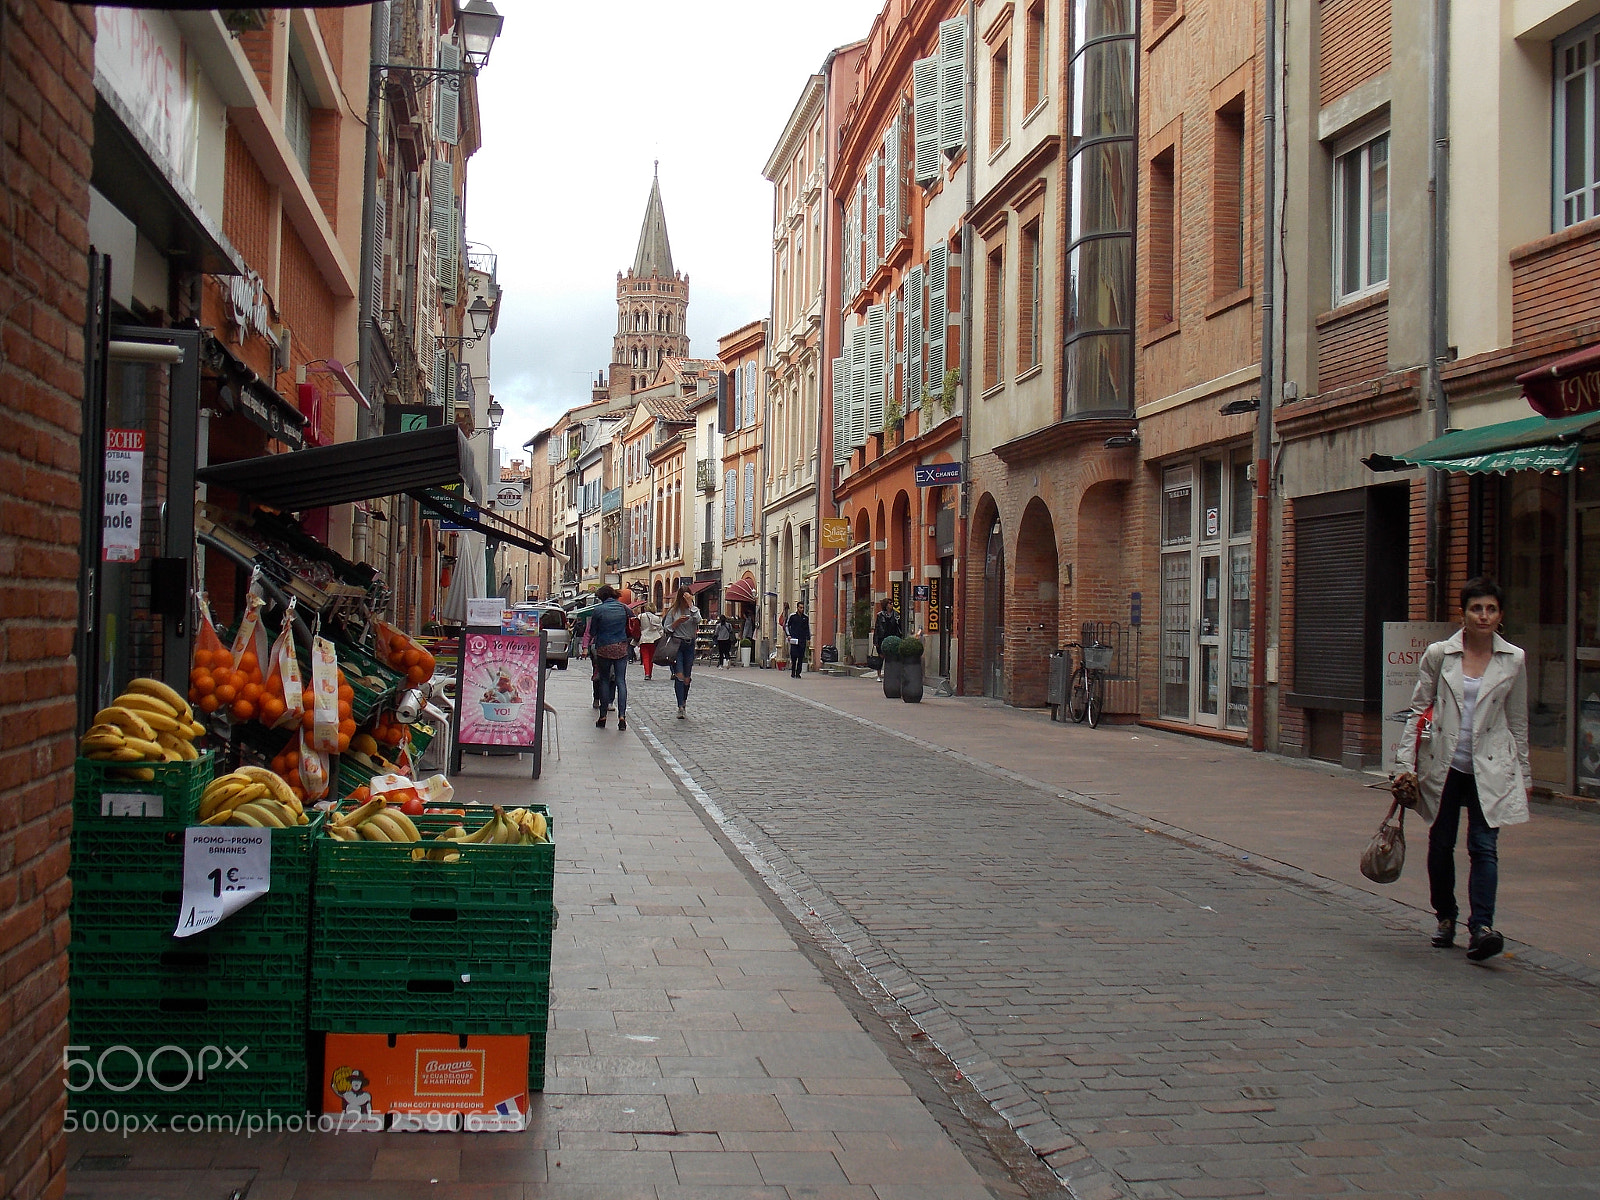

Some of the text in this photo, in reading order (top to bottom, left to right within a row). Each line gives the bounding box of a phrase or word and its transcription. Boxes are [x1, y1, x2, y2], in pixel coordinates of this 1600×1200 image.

[130, 9, 173, 120] PRICE
[106, 430, 143, 449] ÊCHE
[106, 451, 132, 459] OTBALL
[105, 470, 130, 484] use
[104, 493, 128, 506] ure
[469, 638, 488, 650] YO!
[1387, 651, 1427, 666] CAST
[493, 707, 511, 716] YO!
[208, 846, 248, 855] BANANES
[207, 868, 222, 898] 1
[425, 1060, 477, 1073] Banane
